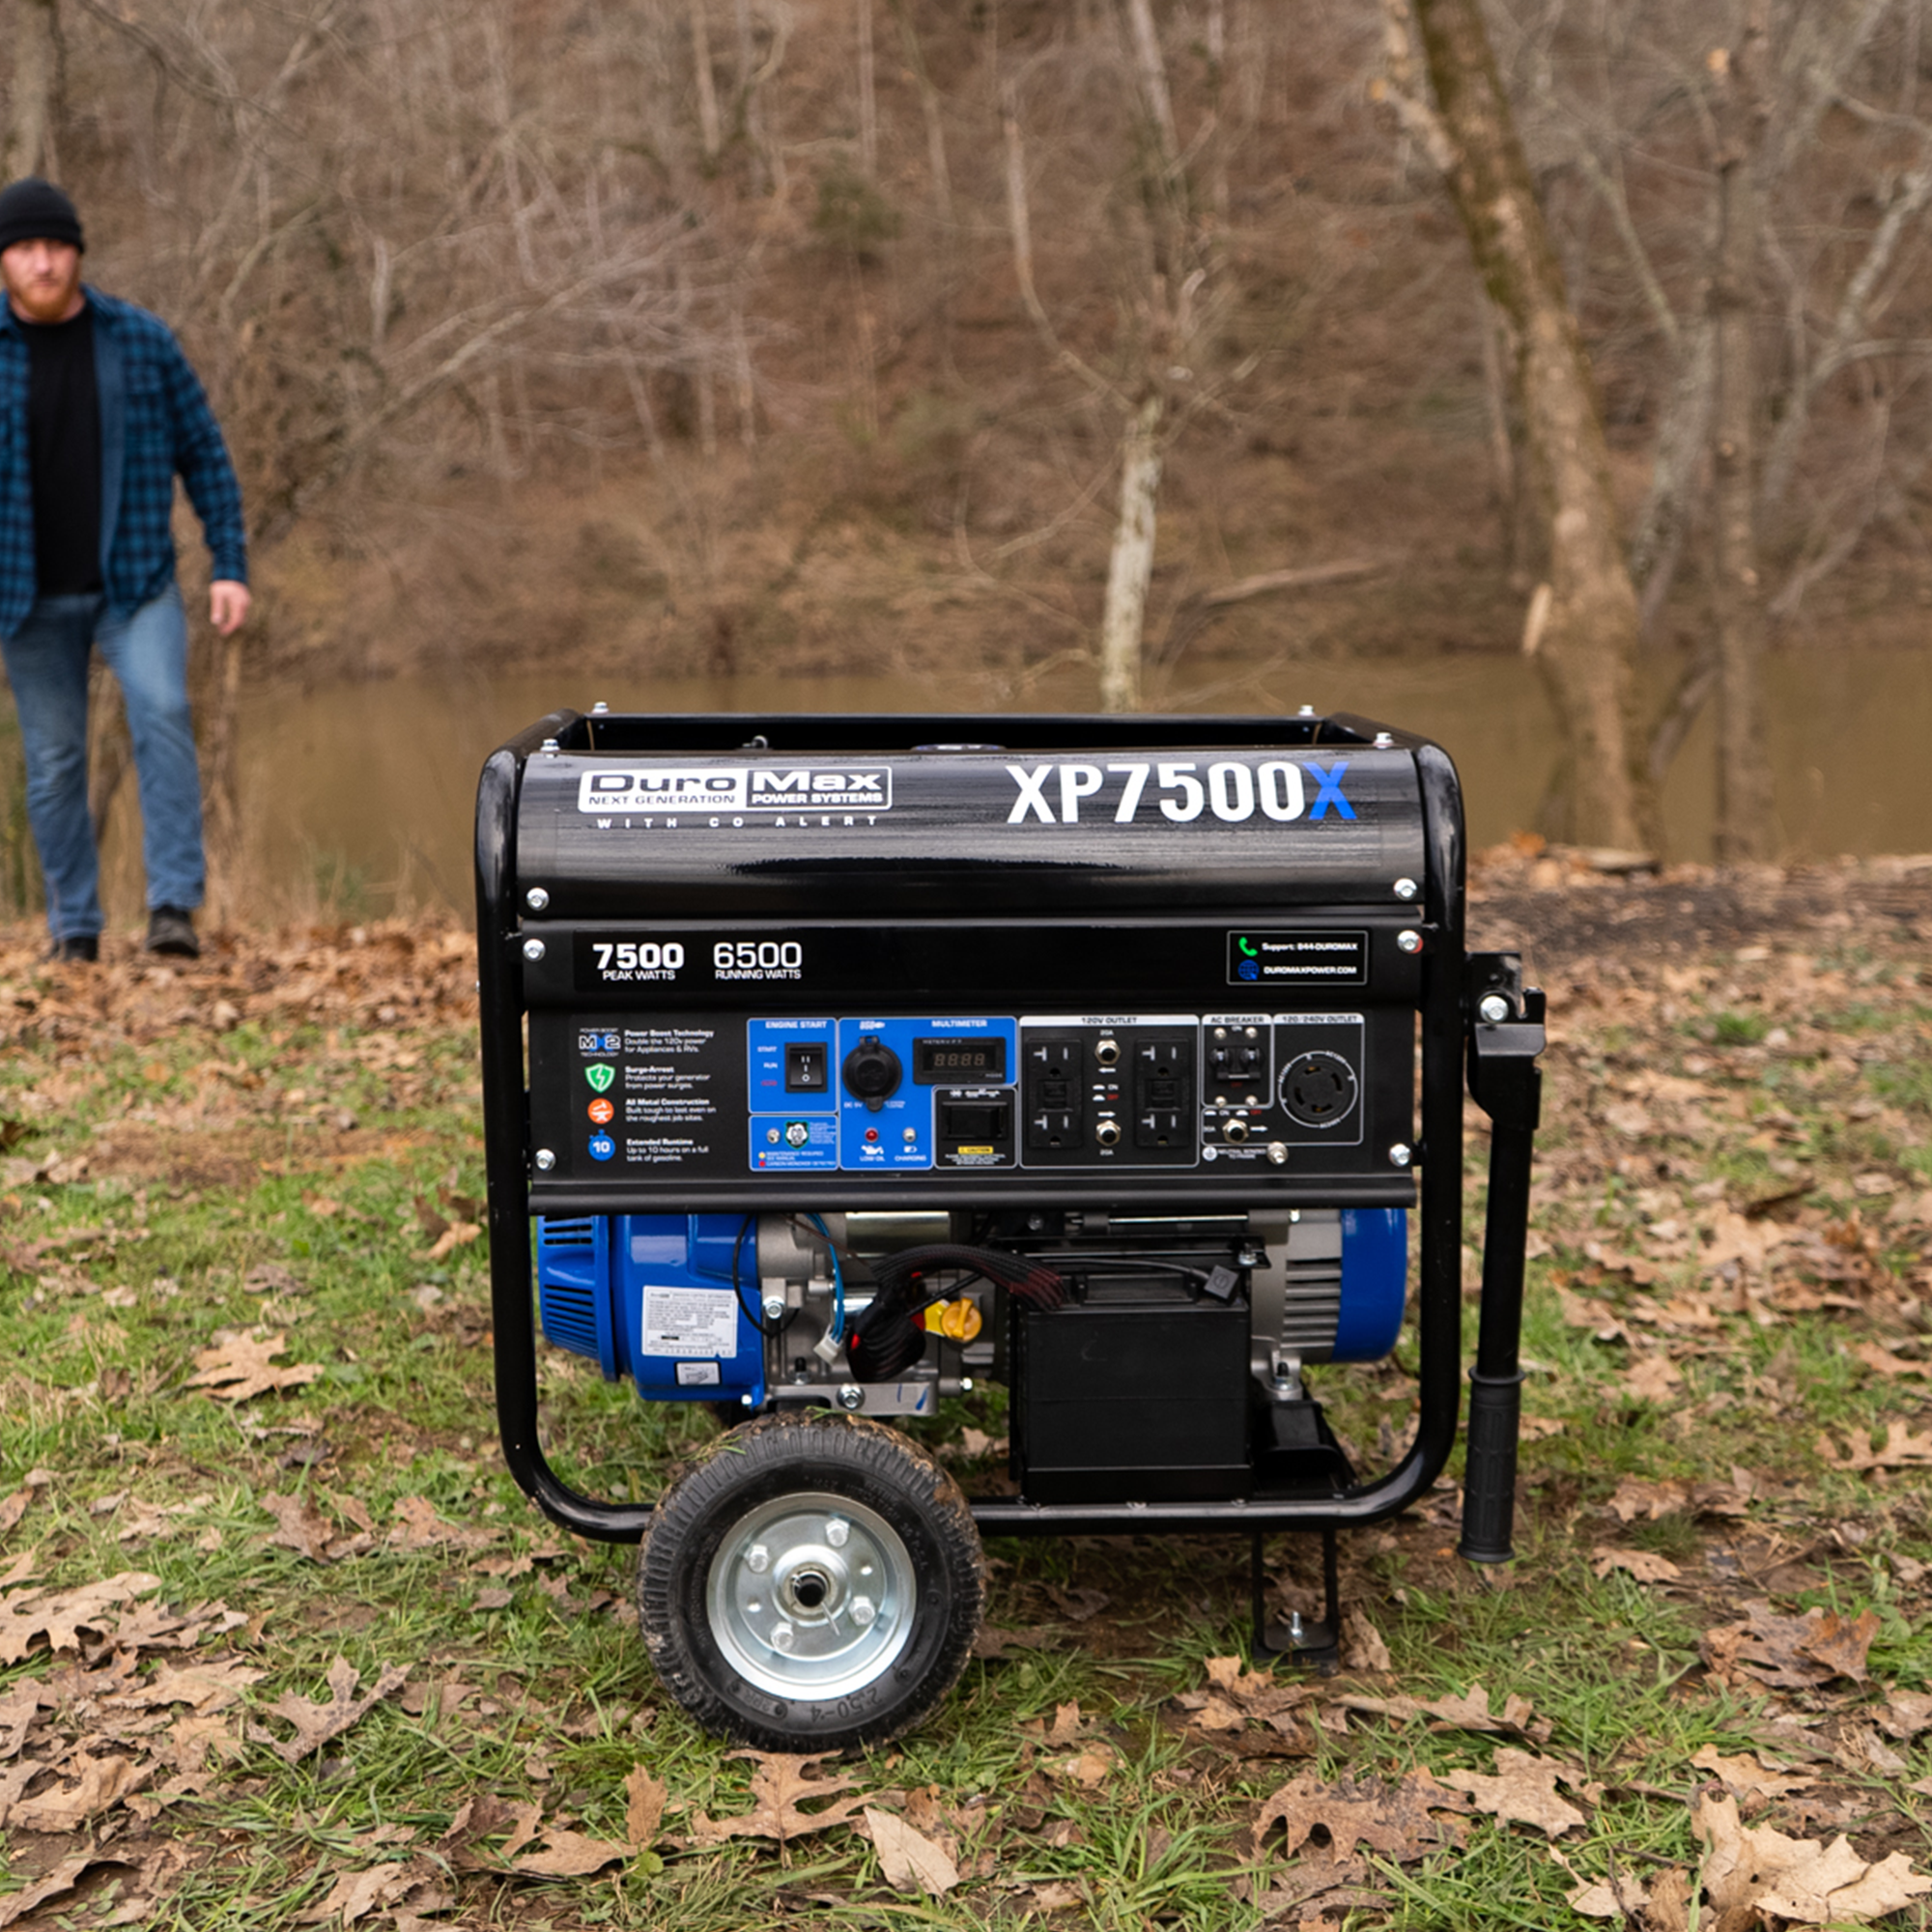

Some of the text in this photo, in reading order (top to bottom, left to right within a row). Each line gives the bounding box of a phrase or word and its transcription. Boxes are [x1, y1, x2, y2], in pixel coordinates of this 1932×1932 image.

[589, 771, 882, 793] Duro Max
[752, 792, 883, 805] POWER SYSTEMS
[1005, 761, 1357, 824] XP7500X
[589, 794, 735, 805] NEXT GENERATION
[597, 815, 876, 829] WITH CO ALERT
[592, 943, 684, 970] 7500
[714, 942, 802, 969] 6500
[603, 970, 675, 980] PEAK WATTS
[715, 969, 802, 980] RUNNING WATTS
[1264, 966, 1357, 975] DUROMAXPOWER.COM
[673, 1030, 714, 1038] Technology
[592, 1142, 611, 1153] 10
